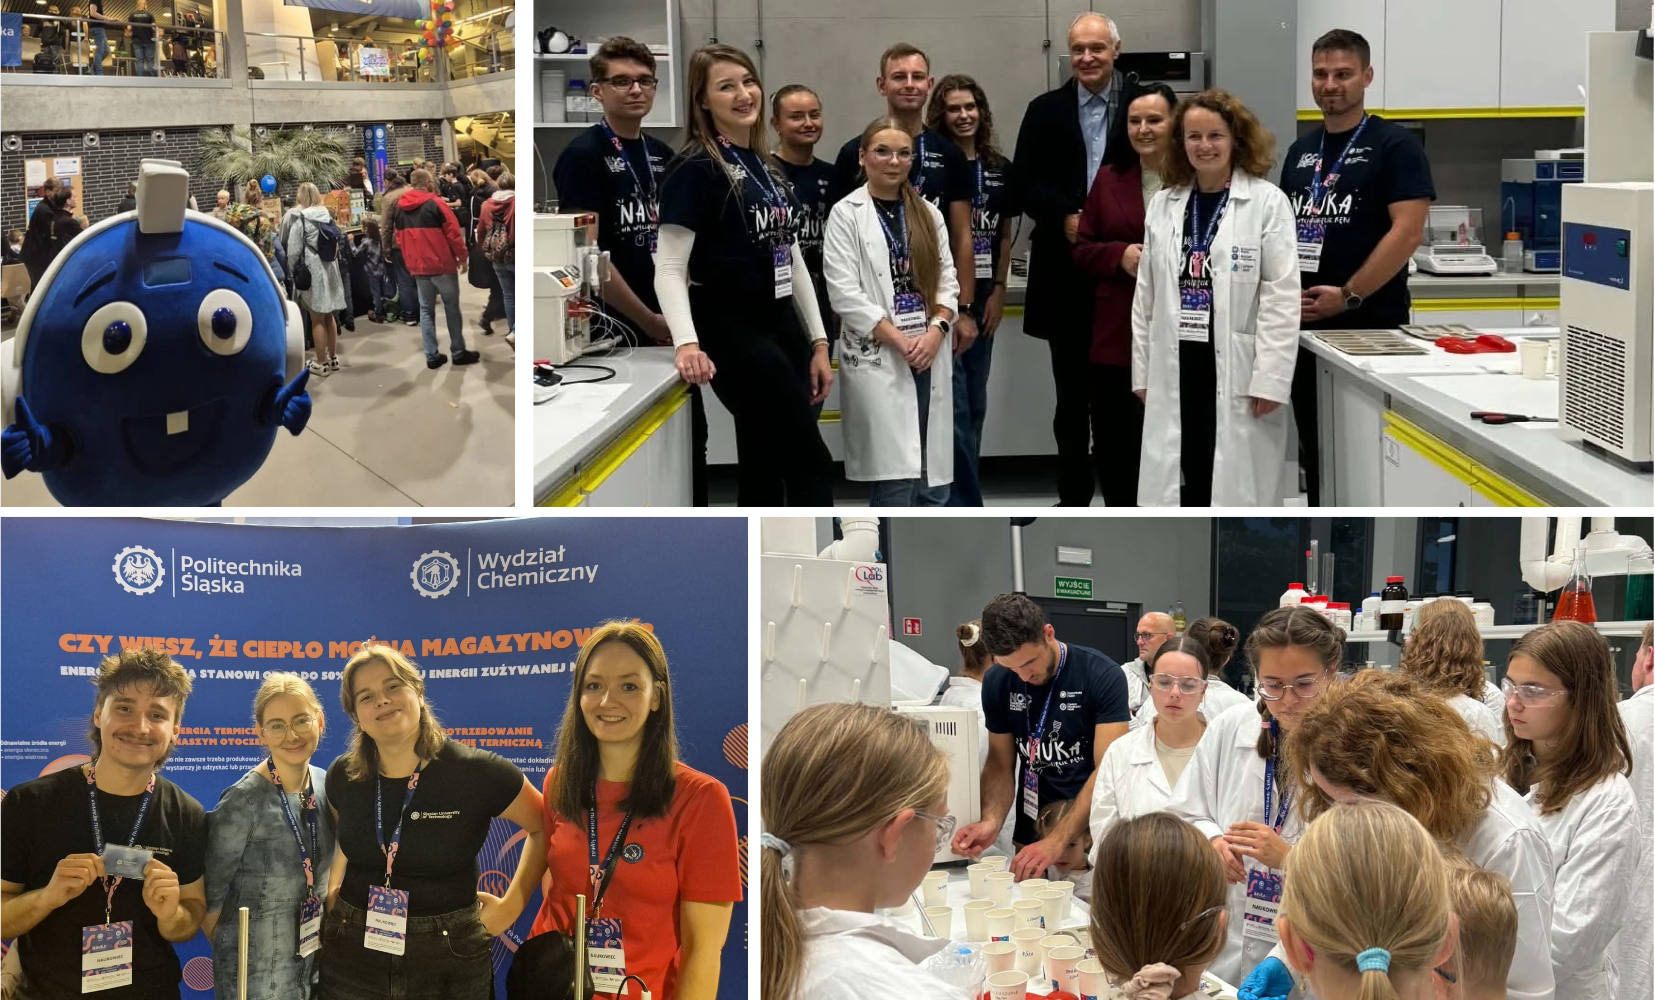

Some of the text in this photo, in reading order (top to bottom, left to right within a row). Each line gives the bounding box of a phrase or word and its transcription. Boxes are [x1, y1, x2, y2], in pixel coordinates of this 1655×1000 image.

[477, 544, 566, 572] Wydział
[181, 555, 302, 577] Politechnika
[477, 564, 599, 590] Chemiczny
[863, 571, 883, 581] Lab
[181, 574, 245, 595] Śląska
[1058, 580, 1090, 590] WYJŚCIE
[59, 633, 113, 653] CZY
[209, 634, 237, 657] ŻE
[242, 640, 323, 658] CIEPŁO
[200, 669, 260, 680] STANOWI
[301, 671, 319, 680] DO
[321, 671, 344, 680] 50%
[429, 668, 478, 679] ENERGII
[481, 662, 566, 677] ZUŻYWANEJ
[479, 738, 543, 749] TERMICZNĄ
[226, 755, 260, 764] produkować
[202, 763, 229, 771] odzyskać
[535, 765, 546, 773] lub
